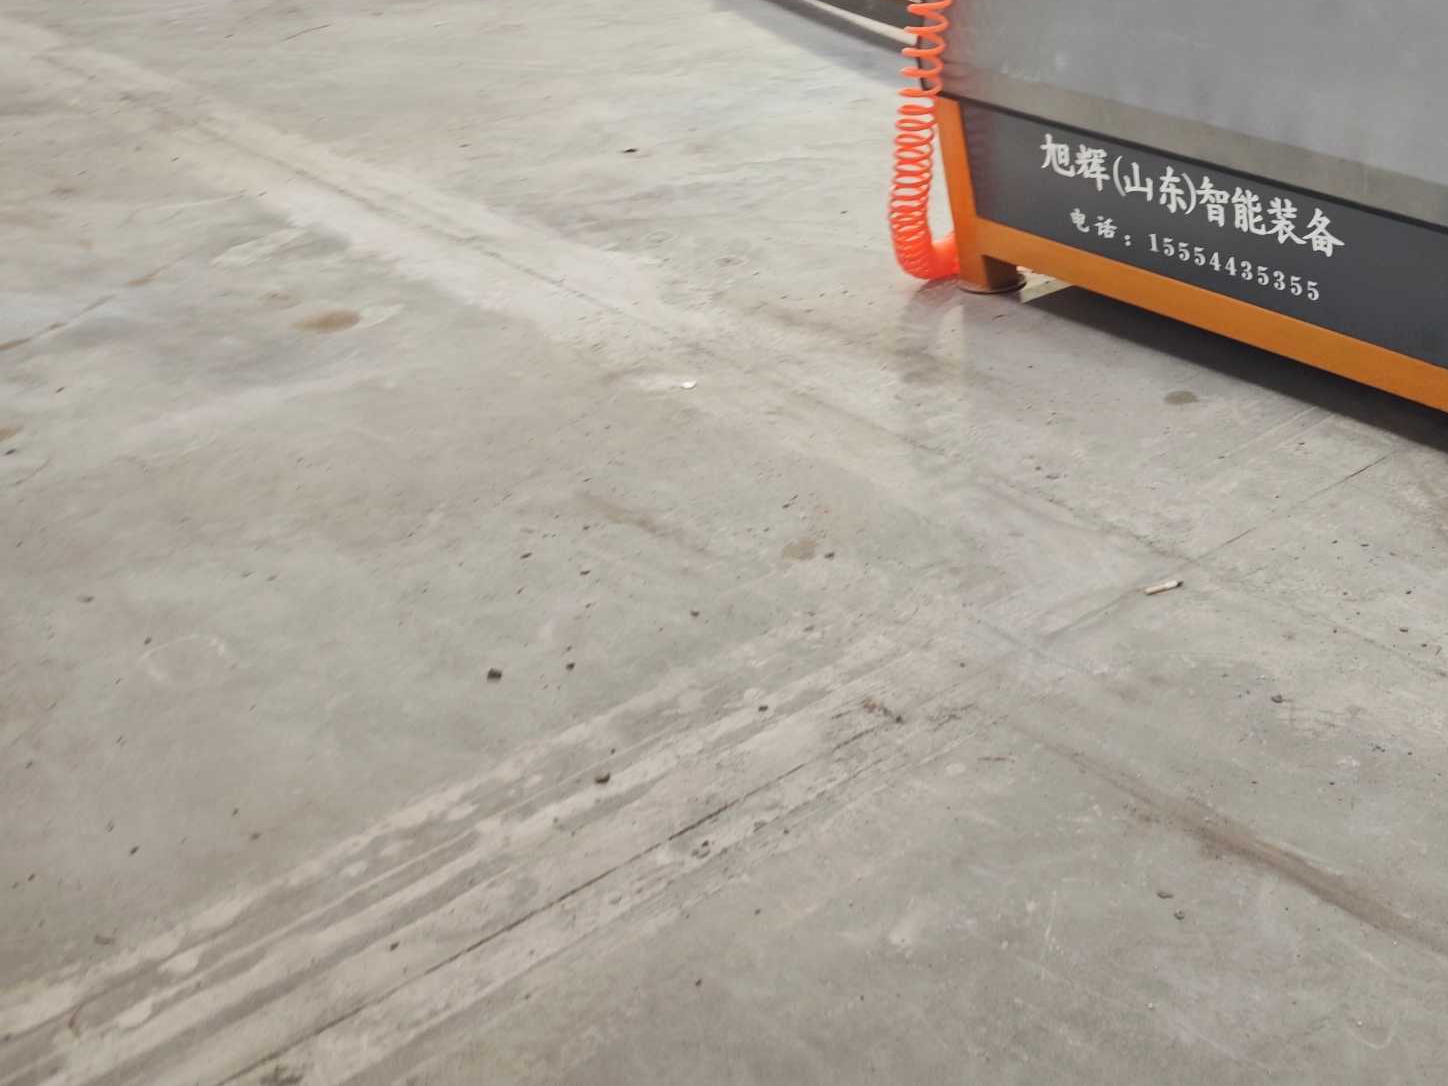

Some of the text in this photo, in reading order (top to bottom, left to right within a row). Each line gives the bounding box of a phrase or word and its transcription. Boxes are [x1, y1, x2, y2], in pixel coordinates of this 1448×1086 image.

[1039, 132, 1346, 258] 旭辉(山东)智能装备
[1148, 233, 1320, 302] 15554435355
